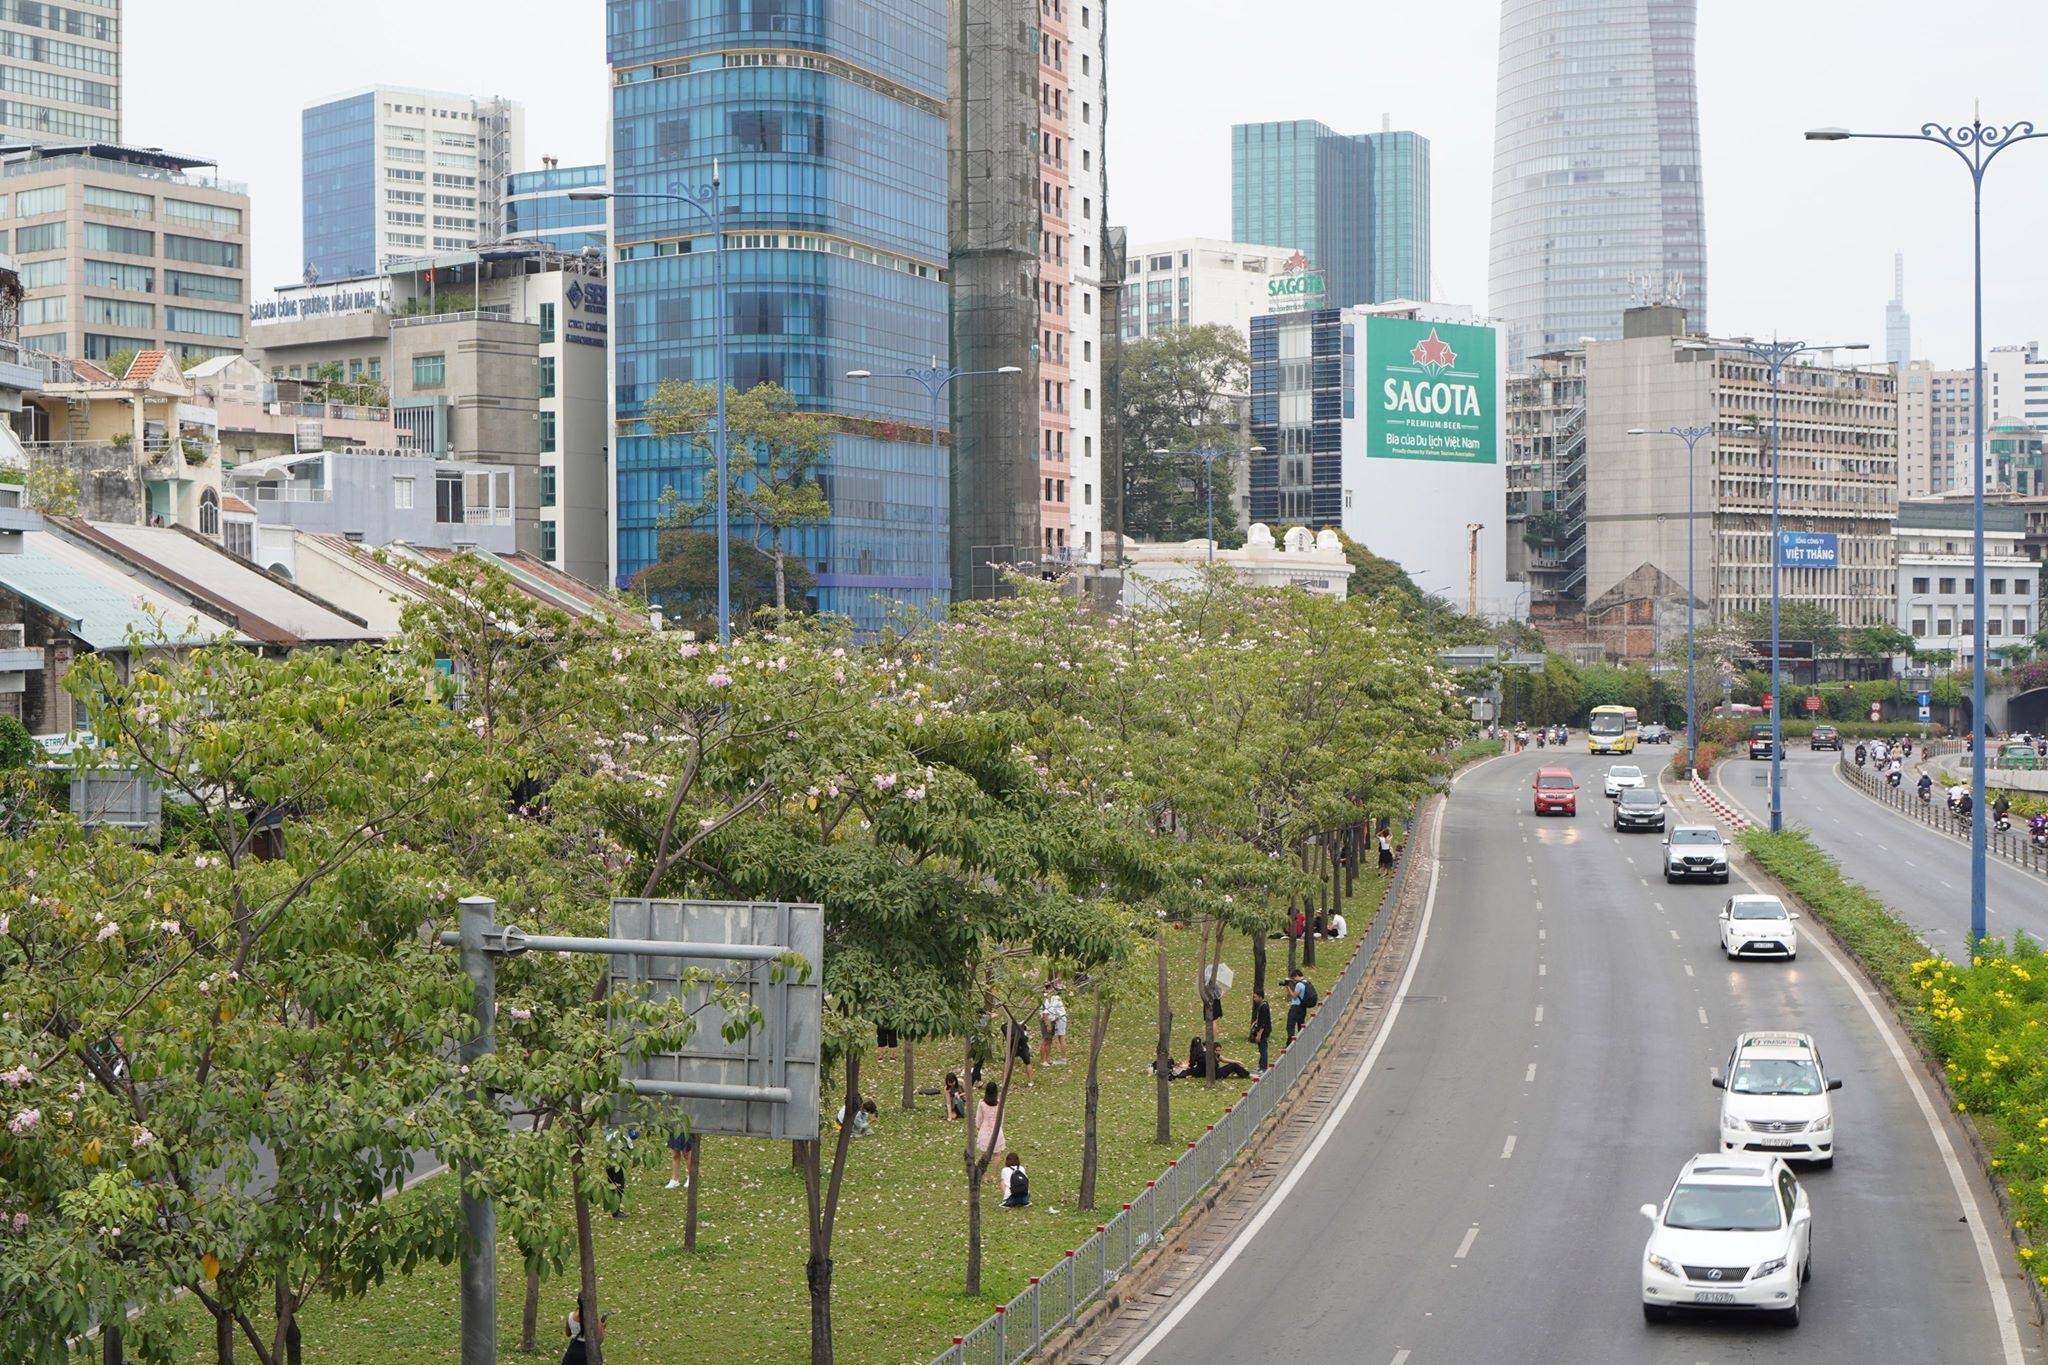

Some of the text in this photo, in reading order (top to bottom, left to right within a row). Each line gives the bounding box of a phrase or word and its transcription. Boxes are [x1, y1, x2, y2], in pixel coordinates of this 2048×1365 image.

[1268, 276, 1325, 296] SAGOTA
[278, 297, 298, 317] CÔNG
[331, 289, 353, 311] NGÂN
[354, 287, 376, 309] HÀNG
[1384, 378, 1481, 416] SAGOTA
[1406, 419, 1461, 430] PREMIUM BEER
[1386, 433, 1480, 450] Bia của Du lịch Việt Nam
[1807, 537, 1819, 545] CÔNG
[1785, 545, 1835, 561] VIỆT THẮNG
